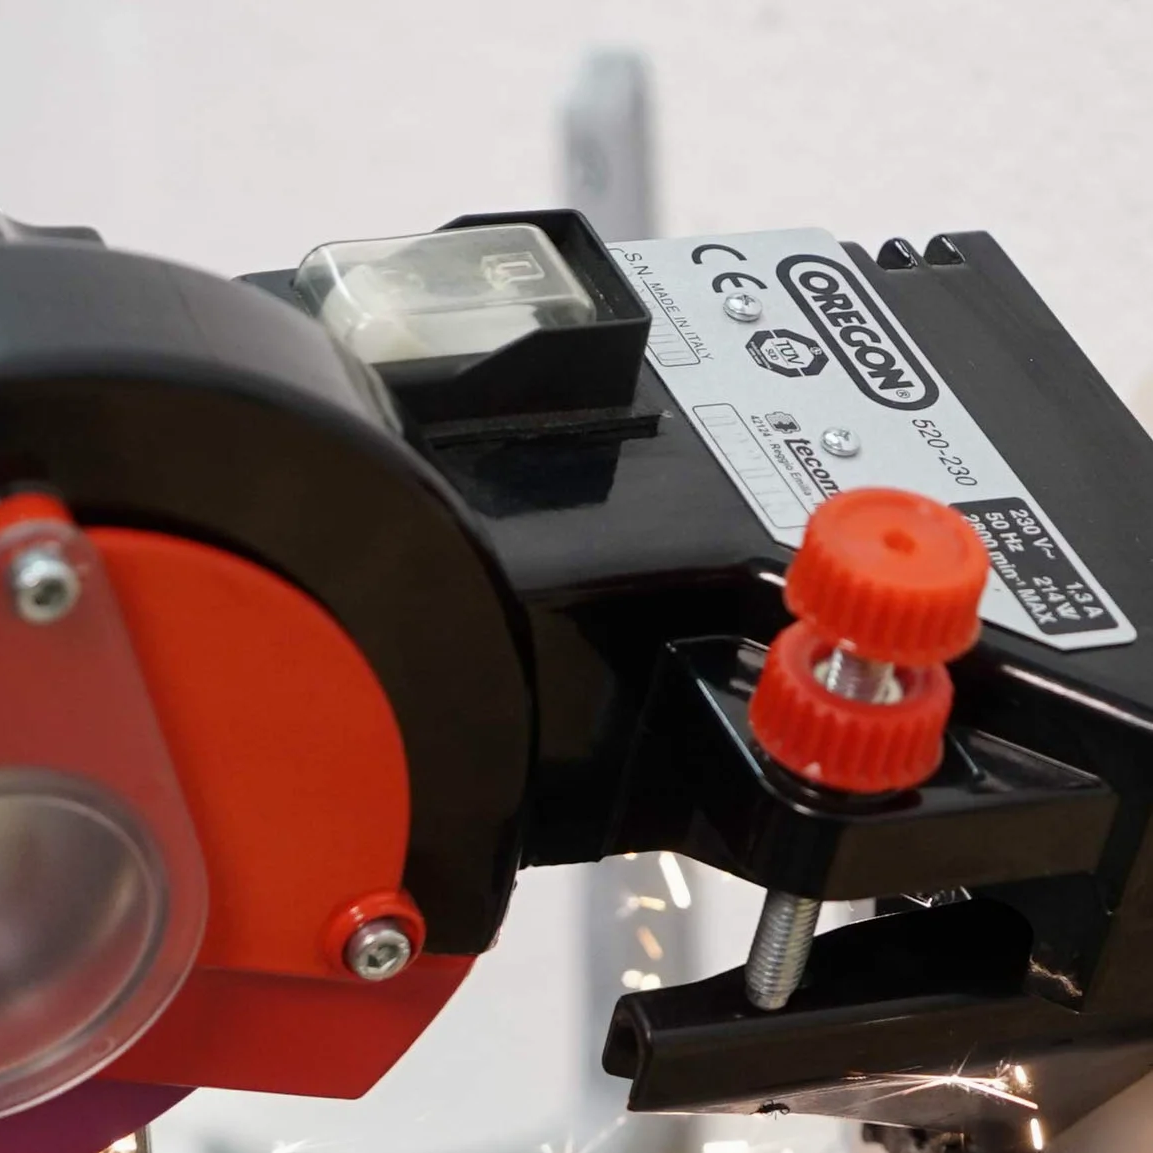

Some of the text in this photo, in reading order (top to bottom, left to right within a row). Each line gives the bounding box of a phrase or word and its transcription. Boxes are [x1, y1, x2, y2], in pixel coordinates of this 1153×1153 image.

[649, 282, 680, 314] MADE
[674, 315, 691, 330] IN
[684, 332, 714, 361] ITALY
[769, 443, 793, 472] Reggio
[790, 472, 812, 496] Emilia
[912, 418, 978, 487] 520-230
[985, 512, 1081, 621] 50 Hz 214 W
[1009, 509, 1041, 536] 230
[1083, 605, 1104, 619] A
[1017, 588, 1058, 625] MAX
